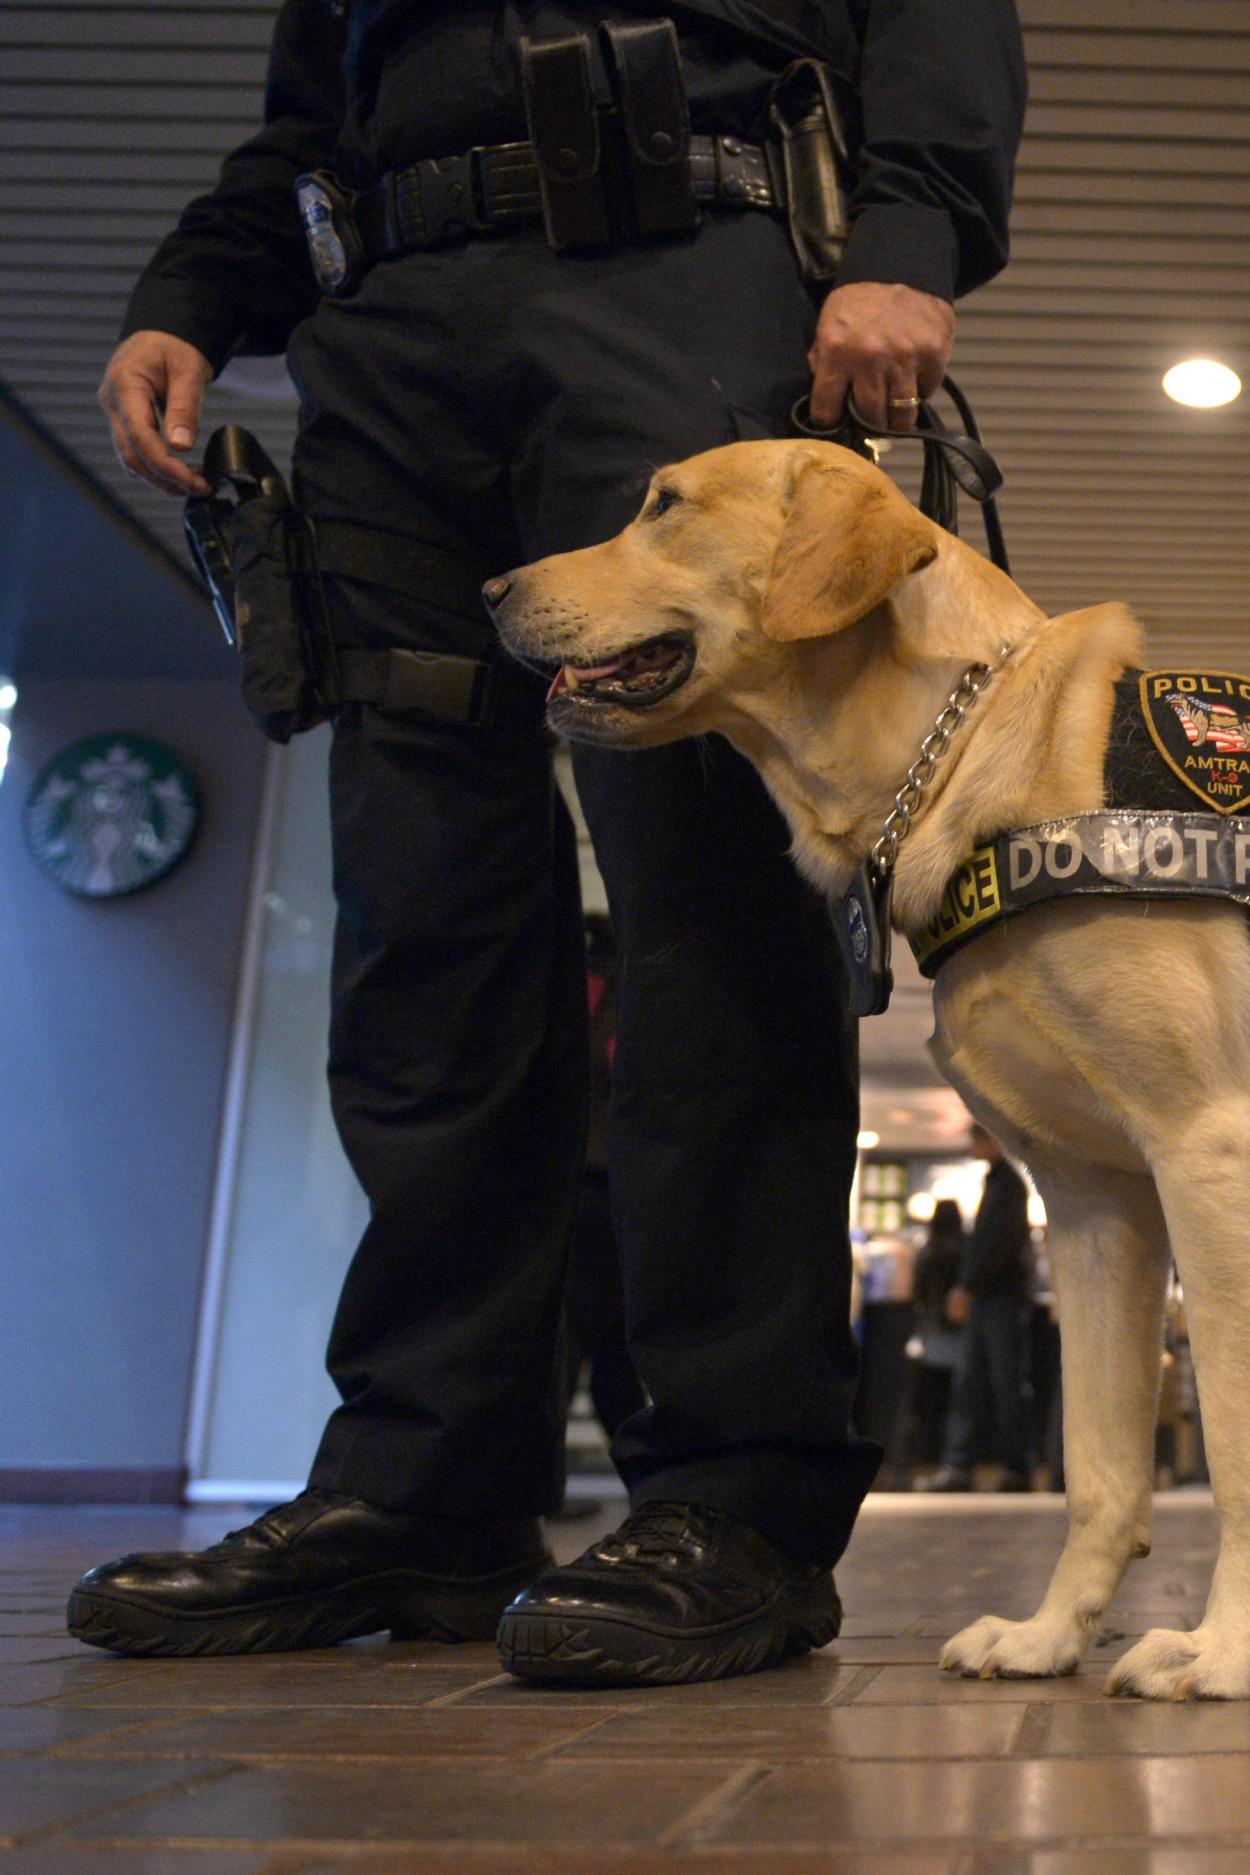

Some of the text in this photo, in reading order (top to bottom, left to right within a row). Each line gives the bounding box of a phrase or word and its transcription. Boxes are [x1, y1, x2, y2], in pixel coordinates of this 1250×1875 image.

[1207, 781, 1243, 796] UNIT
[1211, 771, 1240, 785] K-9
[1008, 830, 1083, 891] DO
[1104, 826, 1217, 878] NOT
[911, 855, 996, 955] LICE
